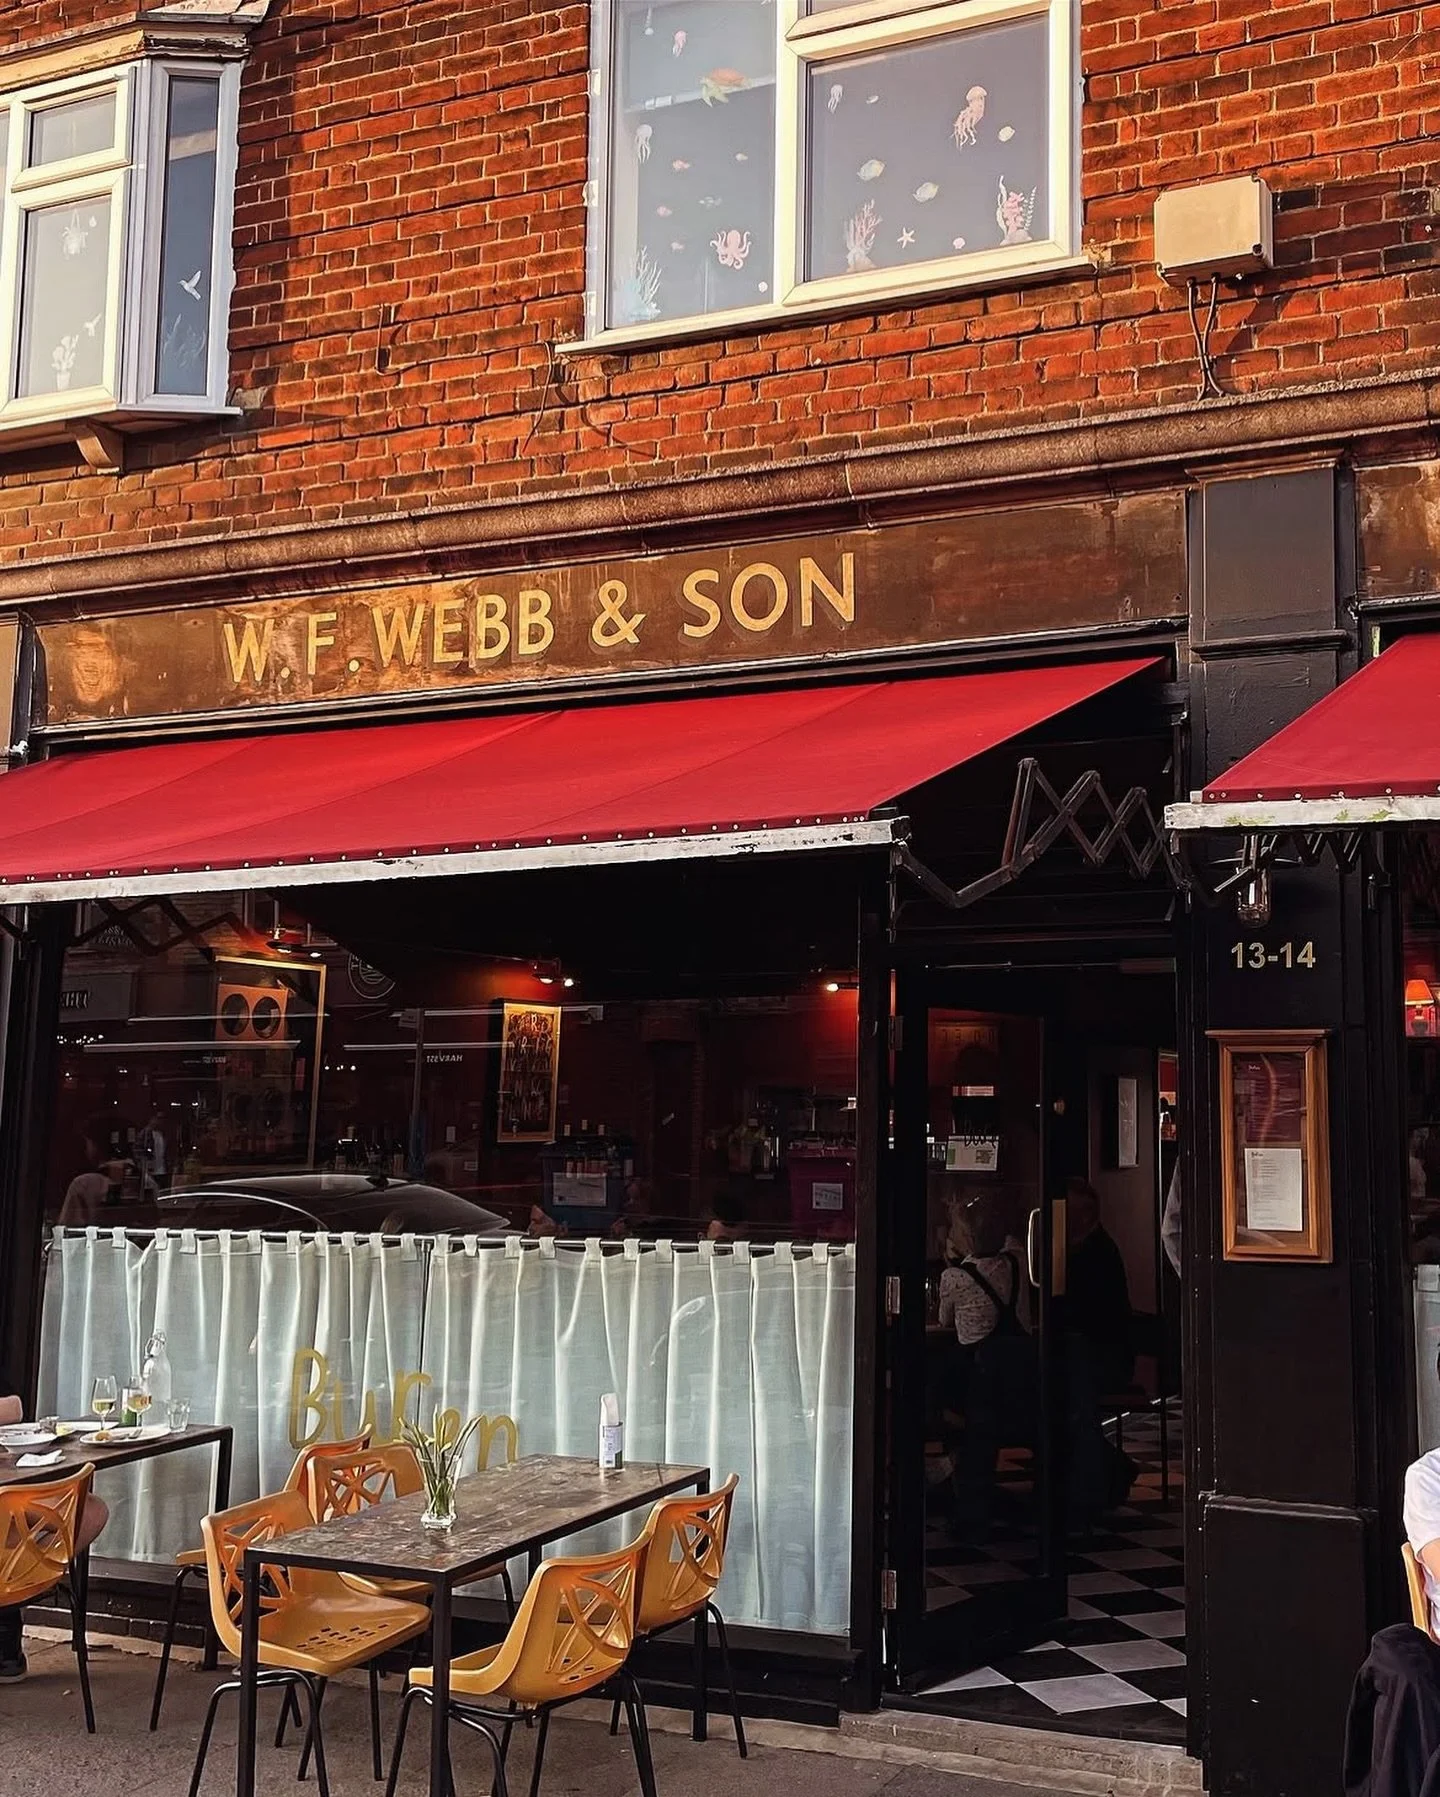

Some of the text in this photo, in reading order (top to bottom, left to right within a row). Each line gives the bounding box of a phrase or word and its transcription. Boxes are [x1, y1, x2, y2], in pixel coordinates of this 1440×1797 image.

[223, 551, 856, 683] W. F. WEBB & SON
[1231, 941, 1316, 968] 13-14
